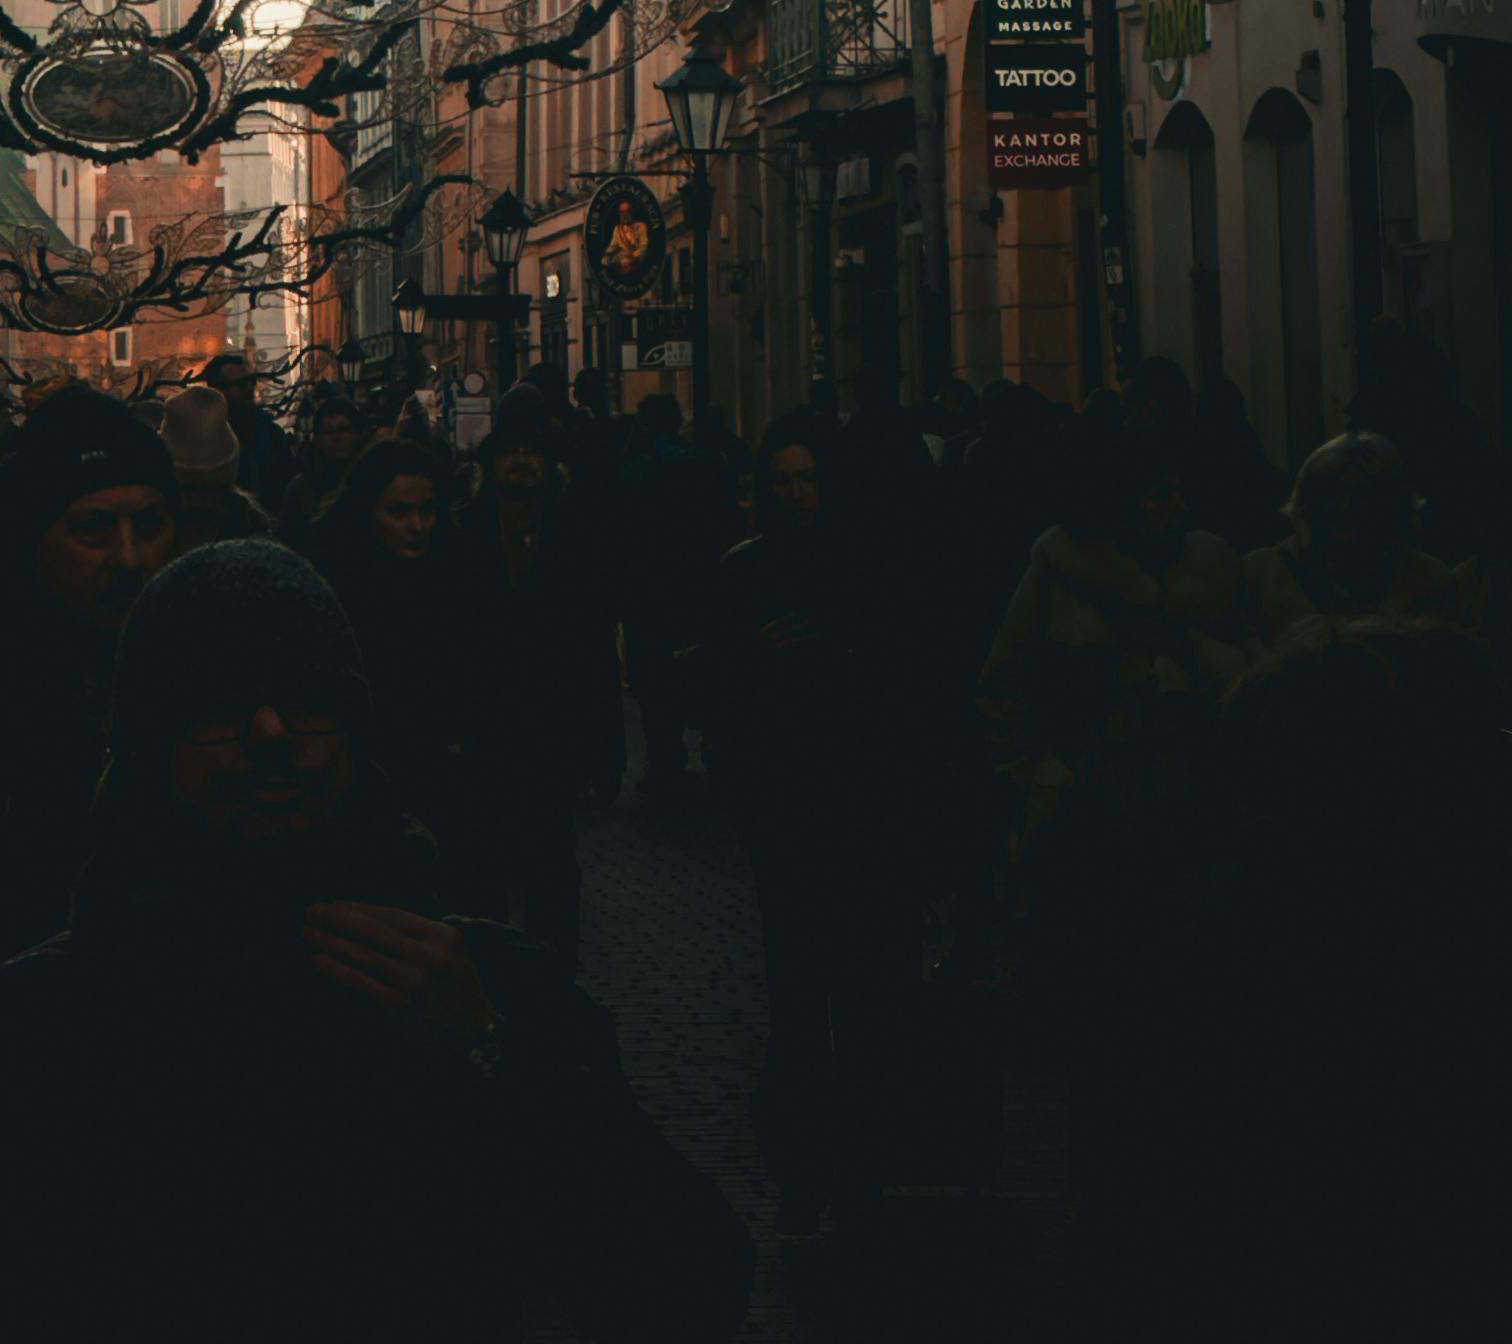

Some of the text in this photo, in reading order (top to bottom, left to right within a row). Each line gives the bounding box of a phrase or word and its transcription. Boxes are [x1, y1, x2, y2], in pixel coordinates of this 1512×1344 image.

[998, 20, 1073, 32] MASSAGE
[994, 68, 1077, 87] TATTOO
[994, 132, 1081, 148] KANTOR
[994, 153, 1080, 168] EXCHANGE
